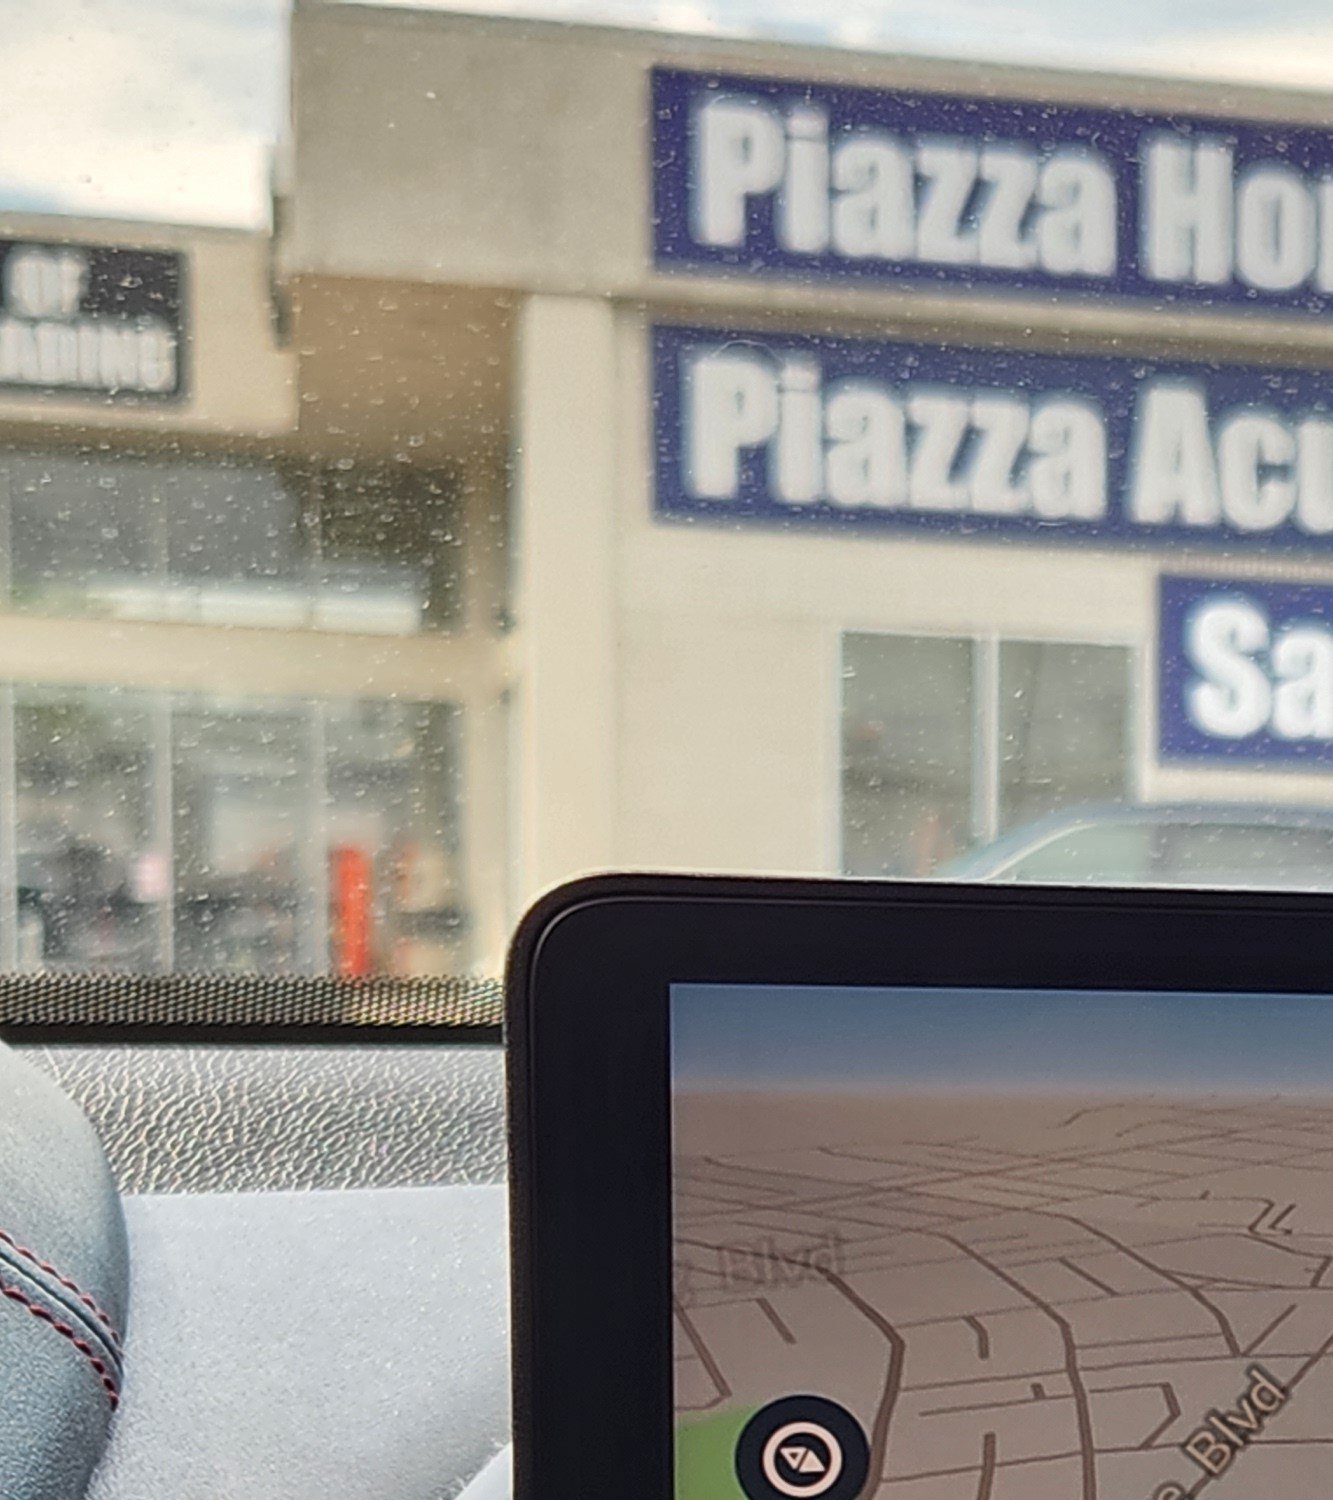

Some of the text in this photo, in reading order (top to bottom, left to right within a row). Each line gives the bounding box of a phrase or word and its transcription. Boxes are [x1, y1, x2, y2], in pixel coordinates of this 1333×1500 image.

[690, 98, 1118, 276] Piazza
[684, 350, 1107, 520] Piazza
[1184, 1365, 1290, 1479] Blvd
